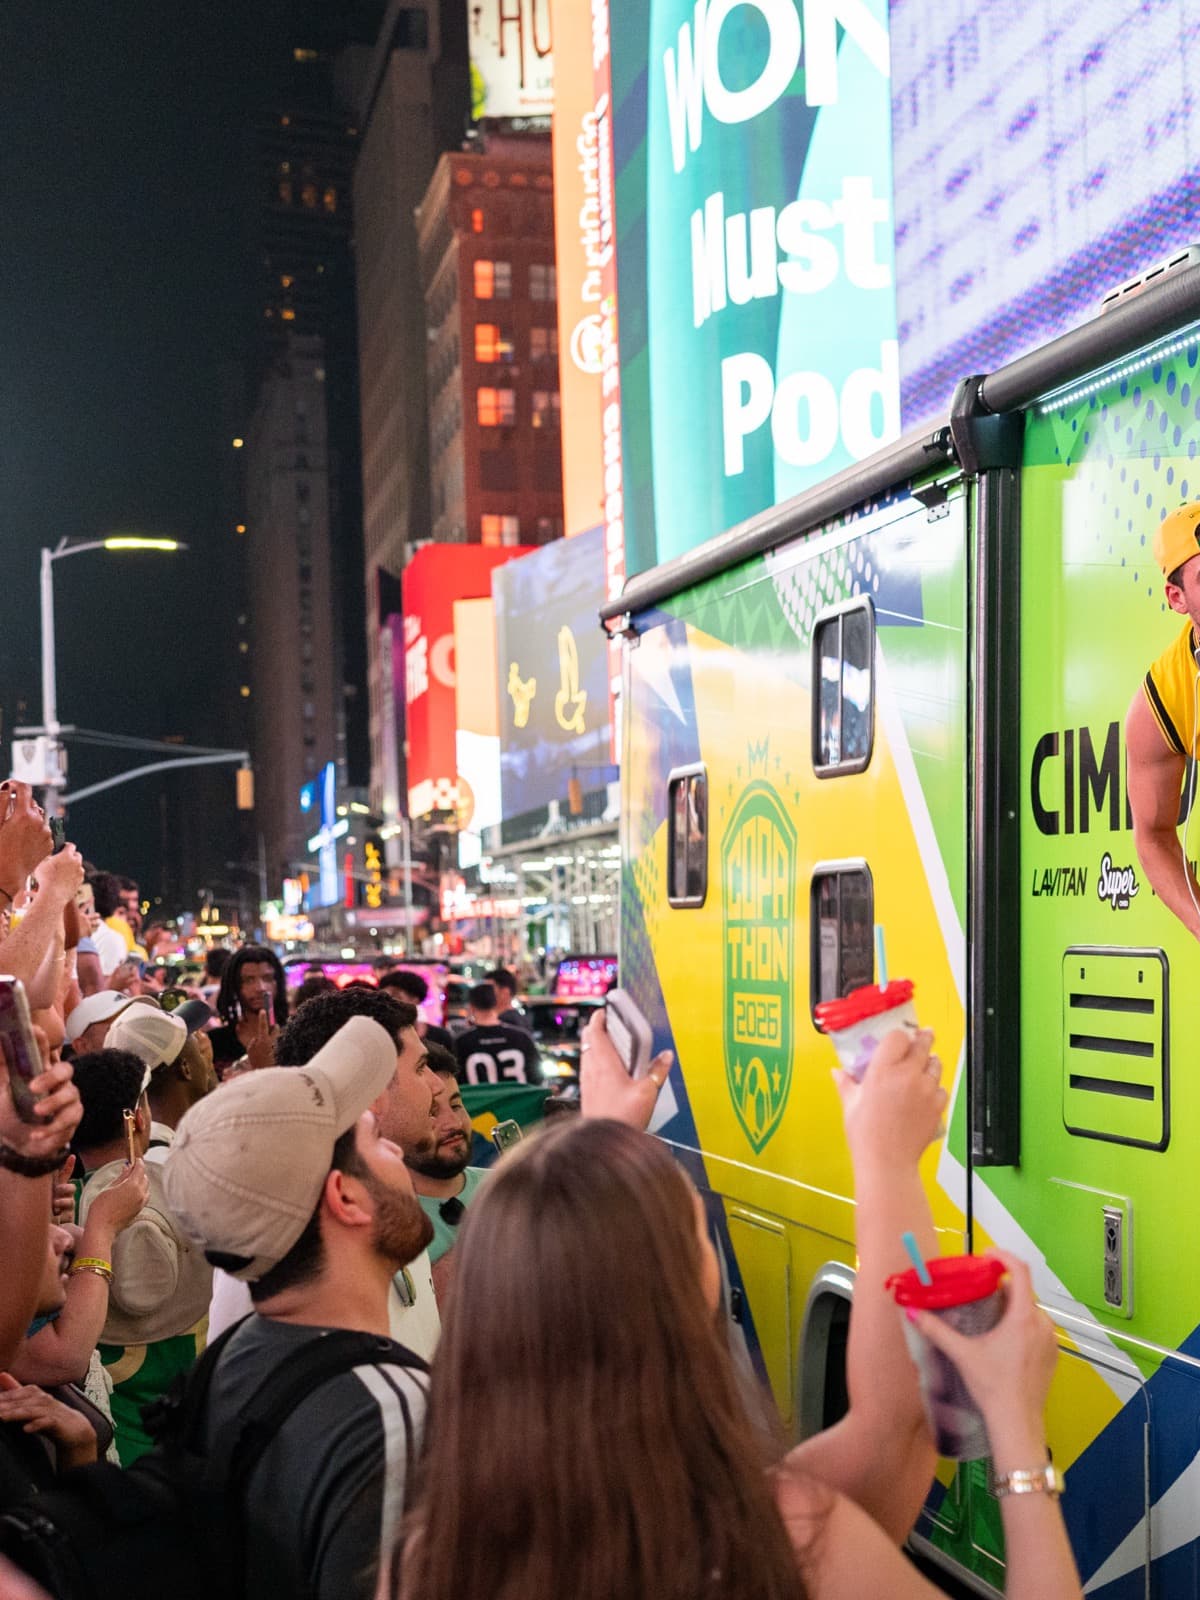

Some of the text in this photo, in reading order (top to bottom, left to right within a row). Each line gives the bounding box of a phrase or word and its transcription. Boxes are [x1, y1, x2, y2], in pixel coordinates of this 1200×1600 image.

[721, 341, 900, 477] Pod
[1031, 721, 1198, 835] CIM
[727, 815, 788, 920] COPA
[1032, 867, 1087, 897] LAVITAN
[1098, 853, 1139, 909] Super
[727, 927, 788, 983] THON
[735, 1000, 779, 1040] 2026
[466, 1049, 527, 1086] 03
